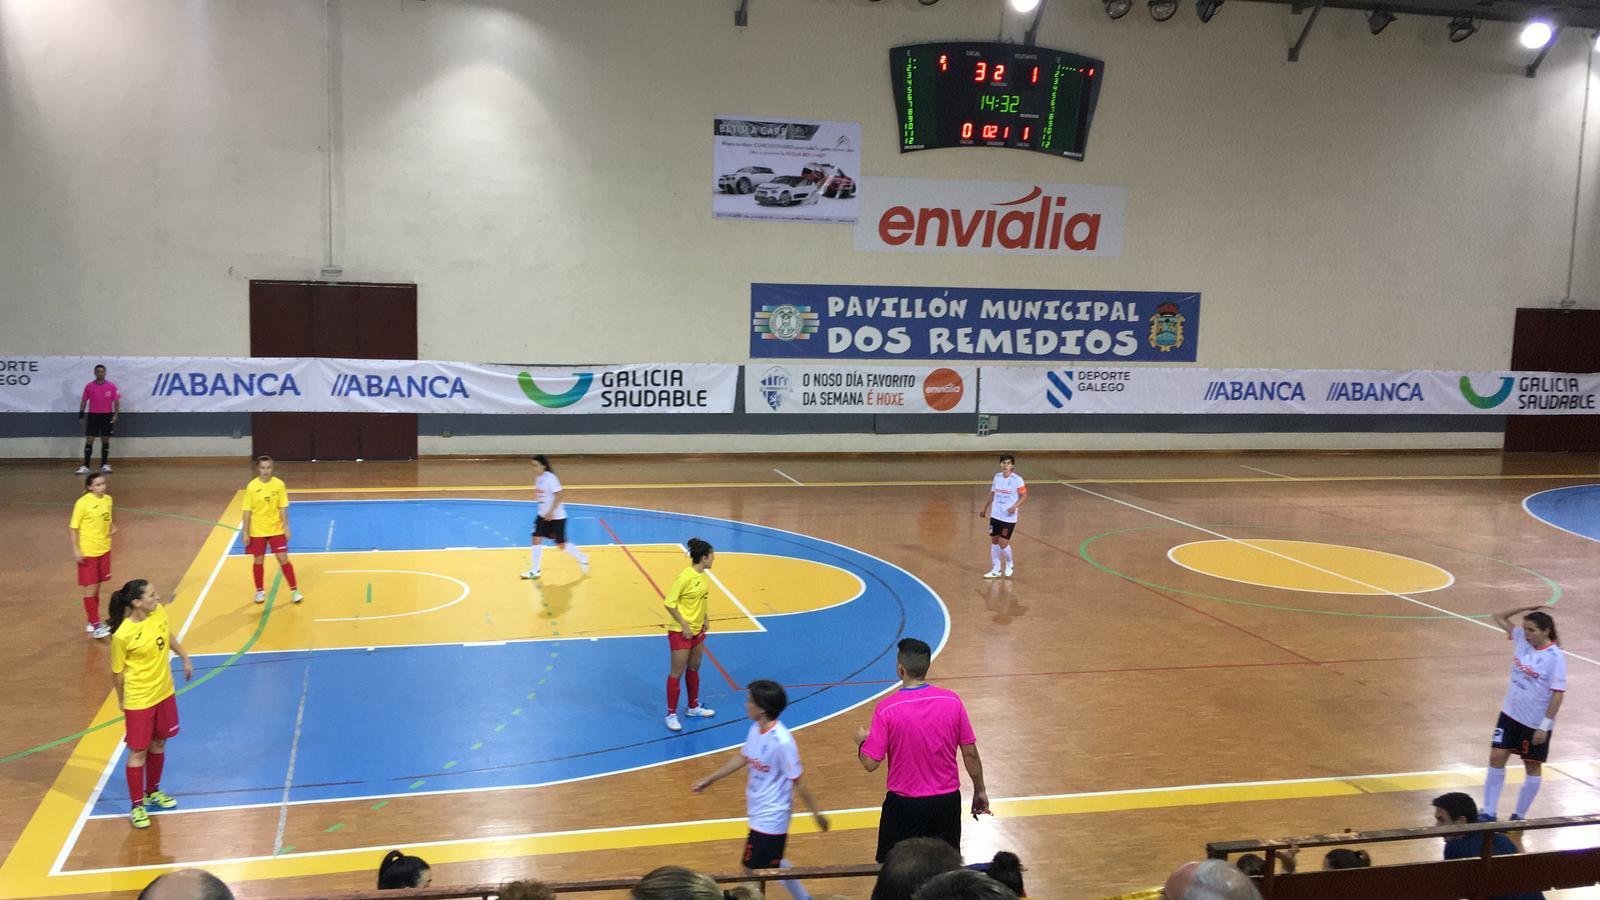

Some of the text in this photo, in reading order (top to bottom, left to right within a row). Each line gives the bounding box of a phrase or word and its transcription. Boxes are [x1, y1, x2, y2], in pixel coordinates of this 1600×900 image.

[975, 62, 987, 81] 3
[992, 64, 1005, 81] 2
[1031, 66, 1039, 83] 1
[980, 94, 1020, 113] 14:32
[961, 122, 973, 138] 0
[1023, 127, 1031, 140] 1
[828, 290, 1140, 322] PAVILLÓN MUNICIPAL
[828, 325, 1138, 356] DOS REMEDIOS
[601, 369, 683, 387] GALICIA
[802, 370, 916, 388] O NOSO DÍA FAVORITO
[1078, 371, 1131, 380] DEPORTE
[1078, 382, 1125, 392] GALEGO
[1519, 377, 1579, 392] GALICIA
[601, 390, 708, 407] SAUDABLE
[802, 389, 905, 406] DA SEMANA É HOXE
[1518, 394, 1596, 410] SAUDABLE
